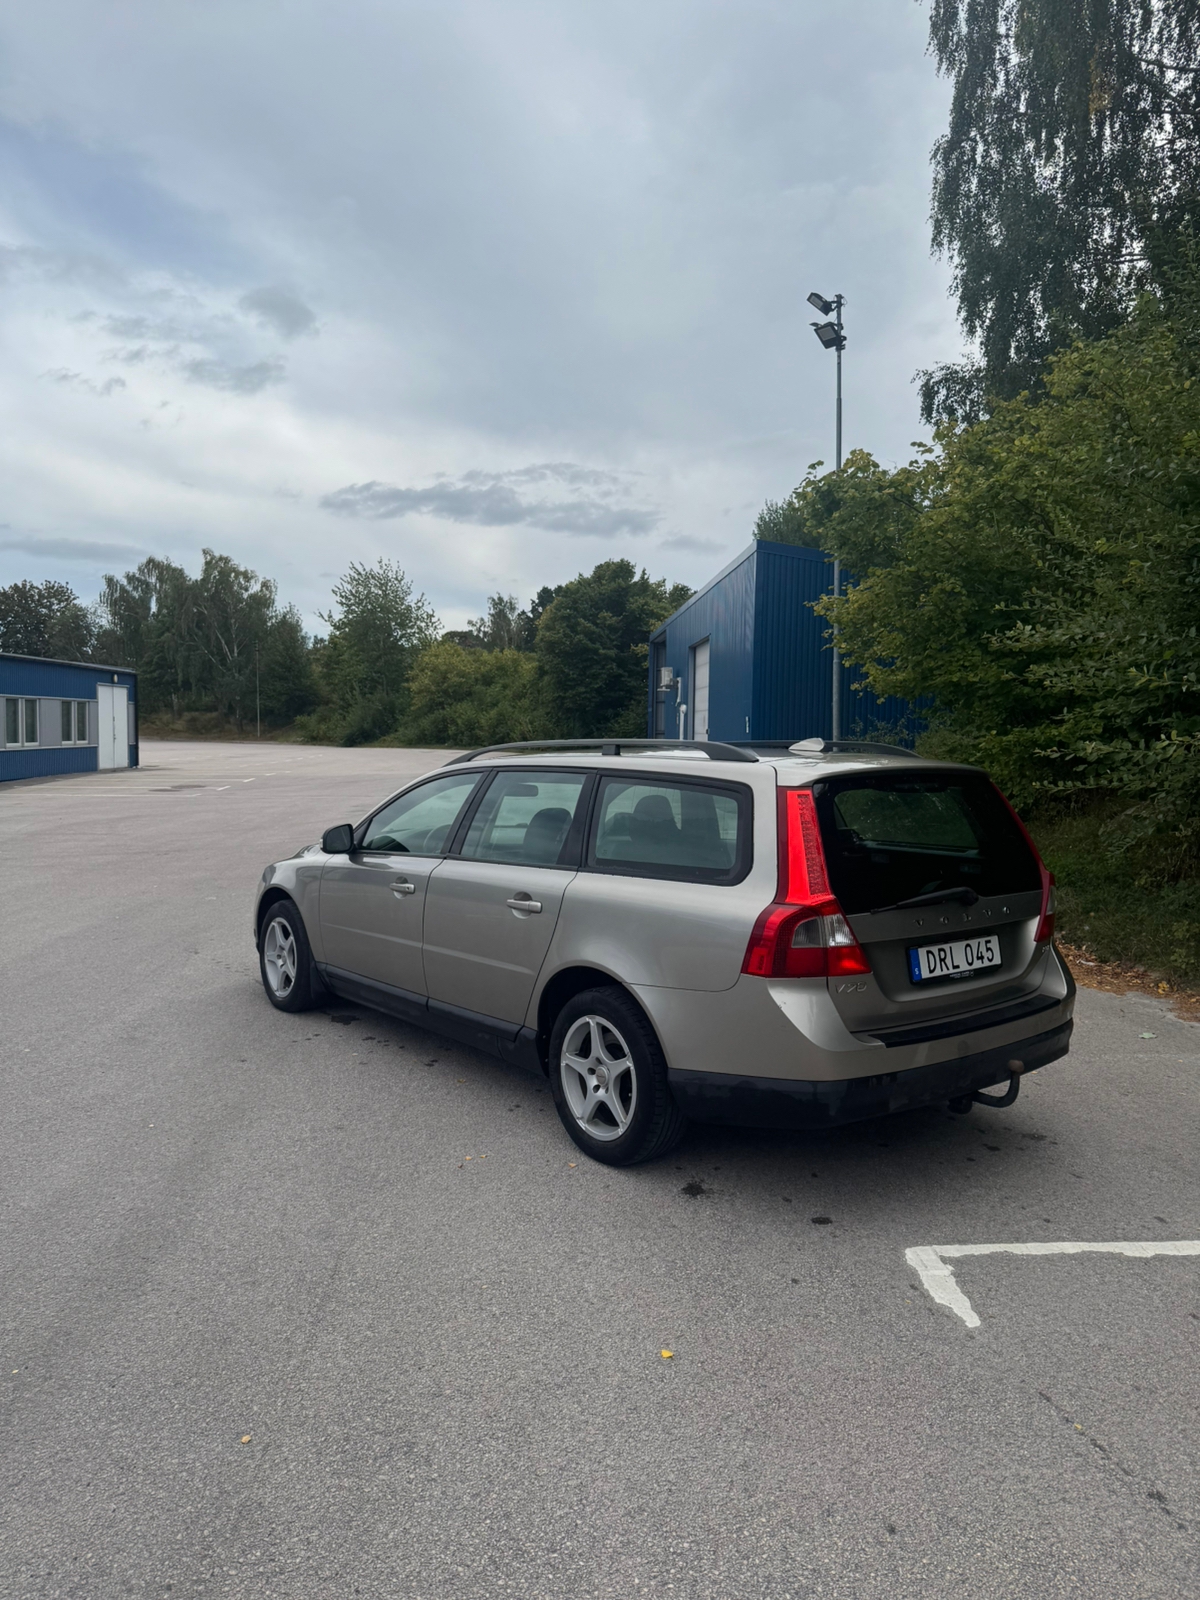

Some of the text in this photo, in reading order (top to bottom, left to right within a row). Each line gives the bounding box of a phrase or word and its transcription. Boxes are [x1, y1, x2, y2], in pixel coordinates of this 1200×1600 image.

[913, 906, 1011, 927] VOLVO
[925, 939, 994, 974] DRL 045
[914, 967, 920, 975] S
[834, 981, 867, 994] V70
